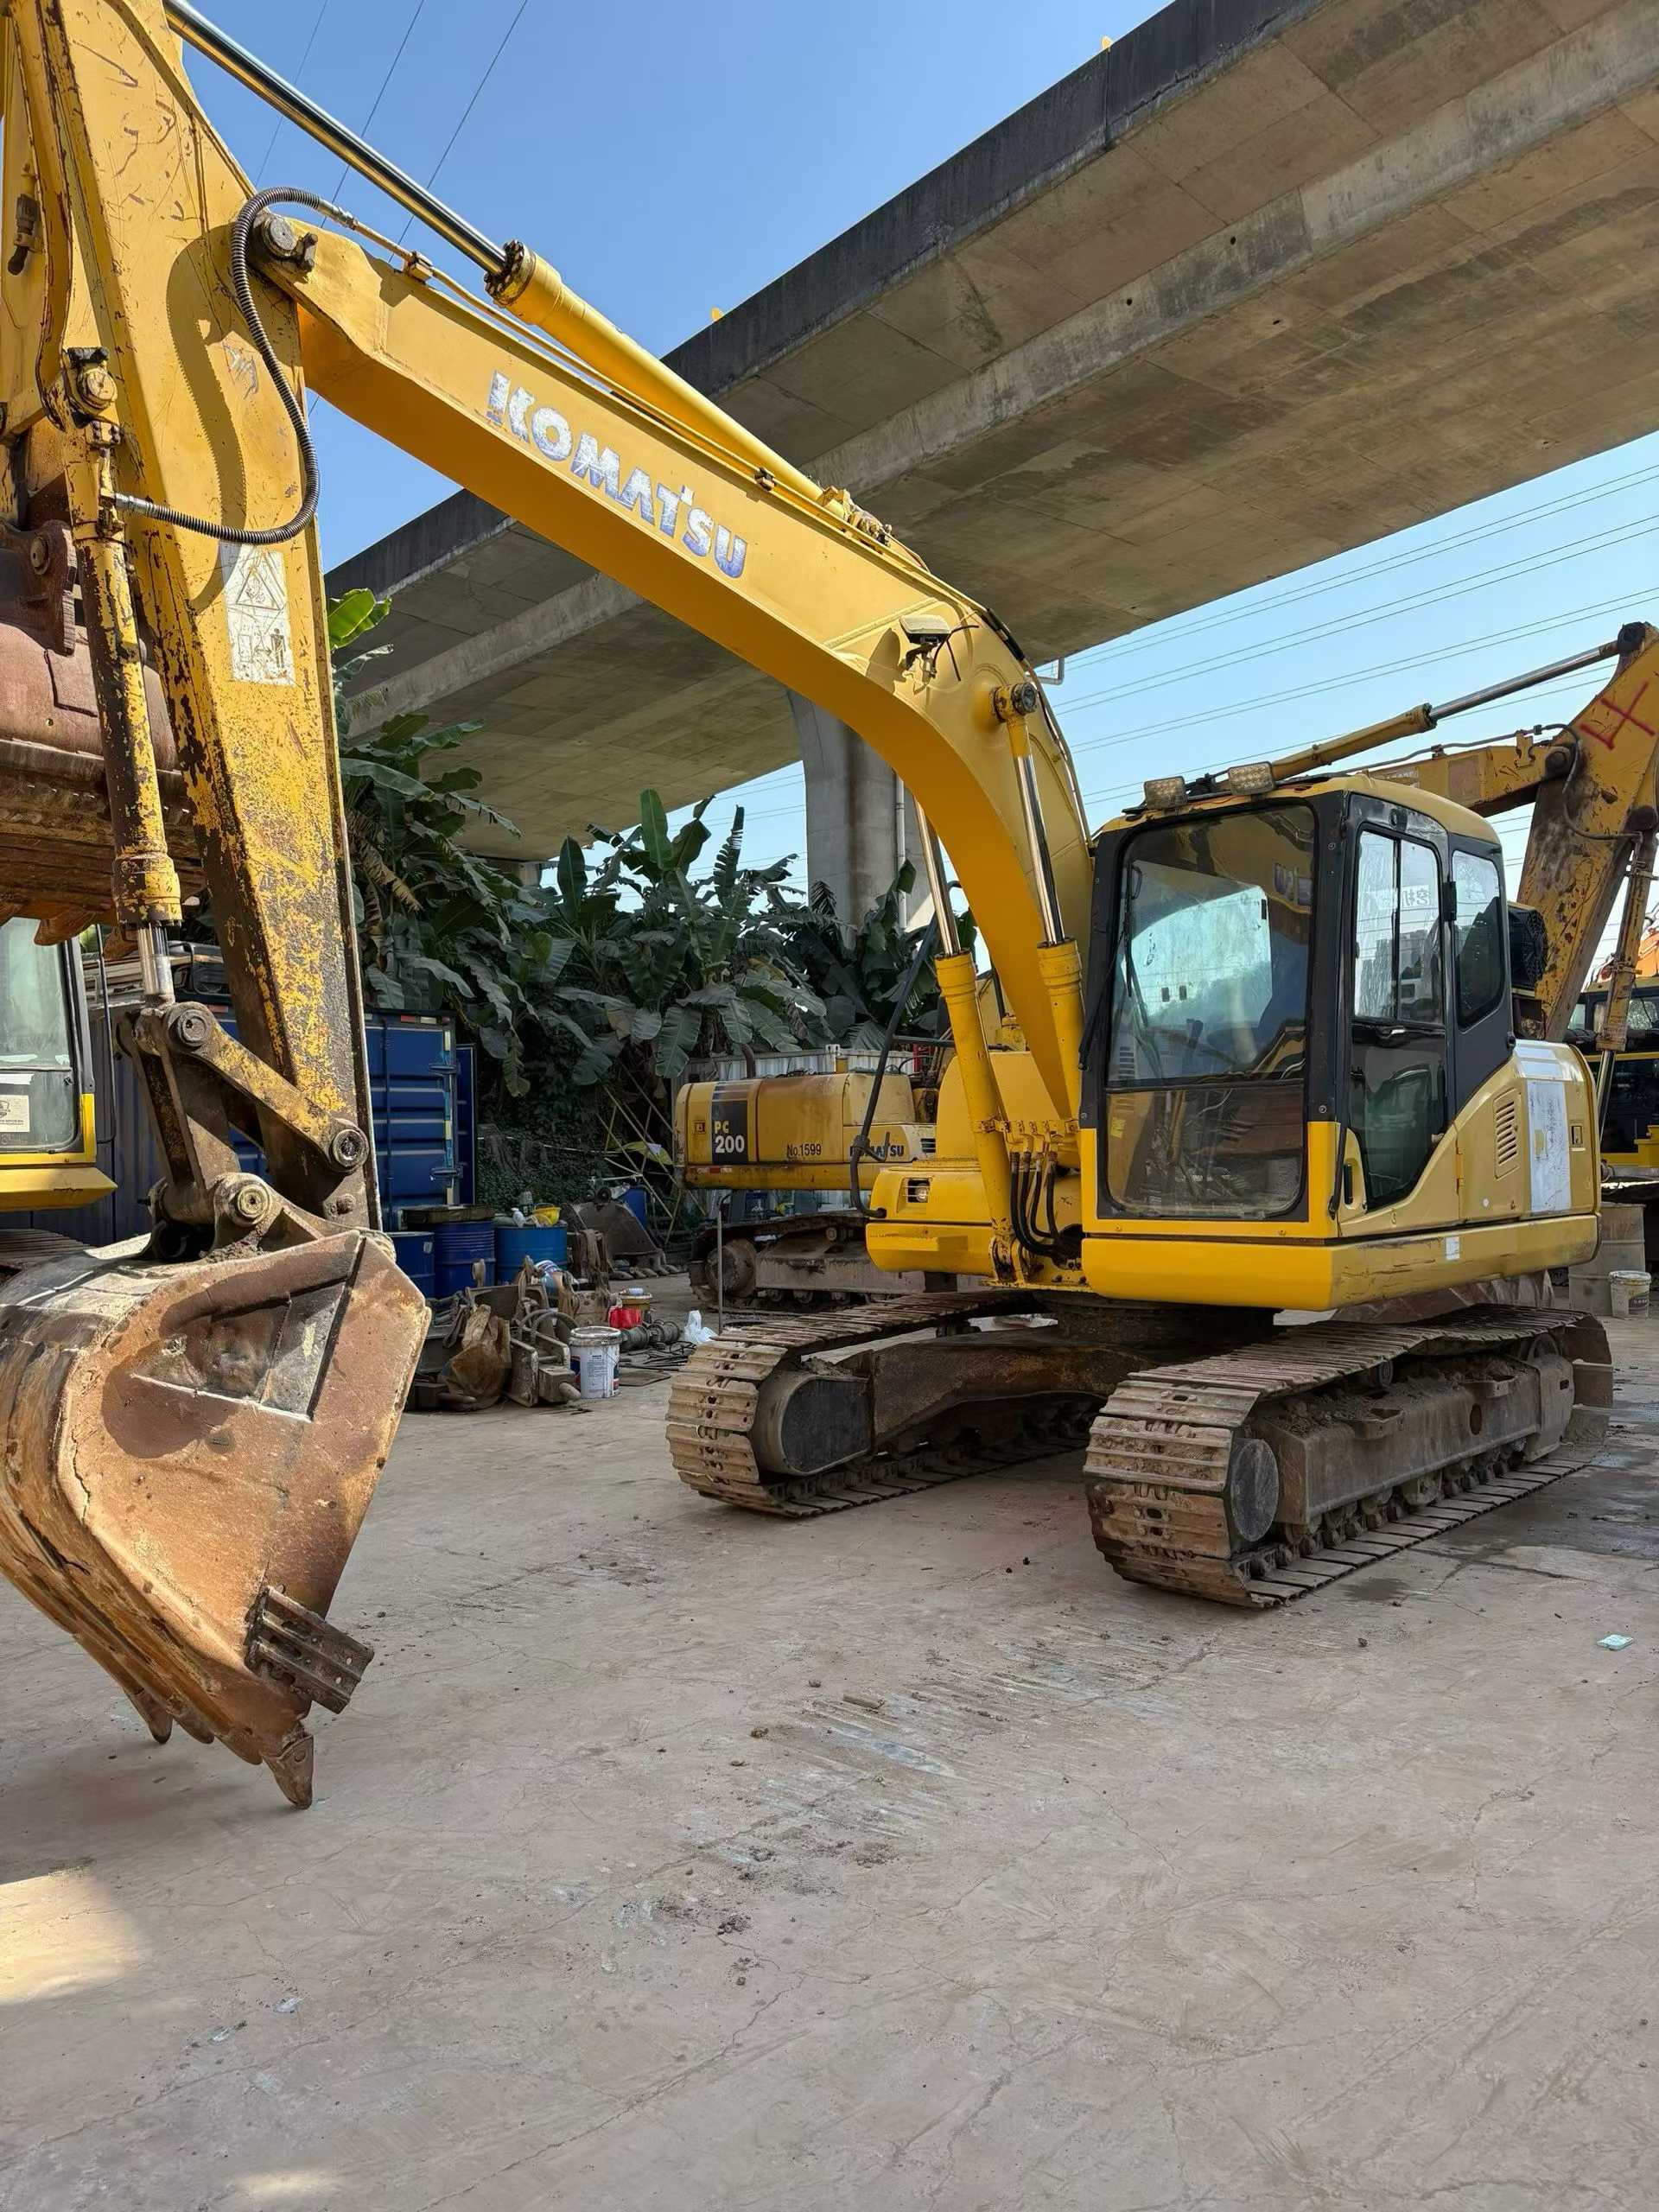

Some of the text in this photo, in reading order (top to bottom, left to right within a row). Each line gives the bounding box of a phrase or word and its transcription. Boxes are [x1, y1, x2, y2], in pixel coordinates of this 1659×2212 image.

[486, 370, 748, 579] KOMATSU
[714, 1120, 729, 1134] PC
[715, 1135, 745, 1154] 200
